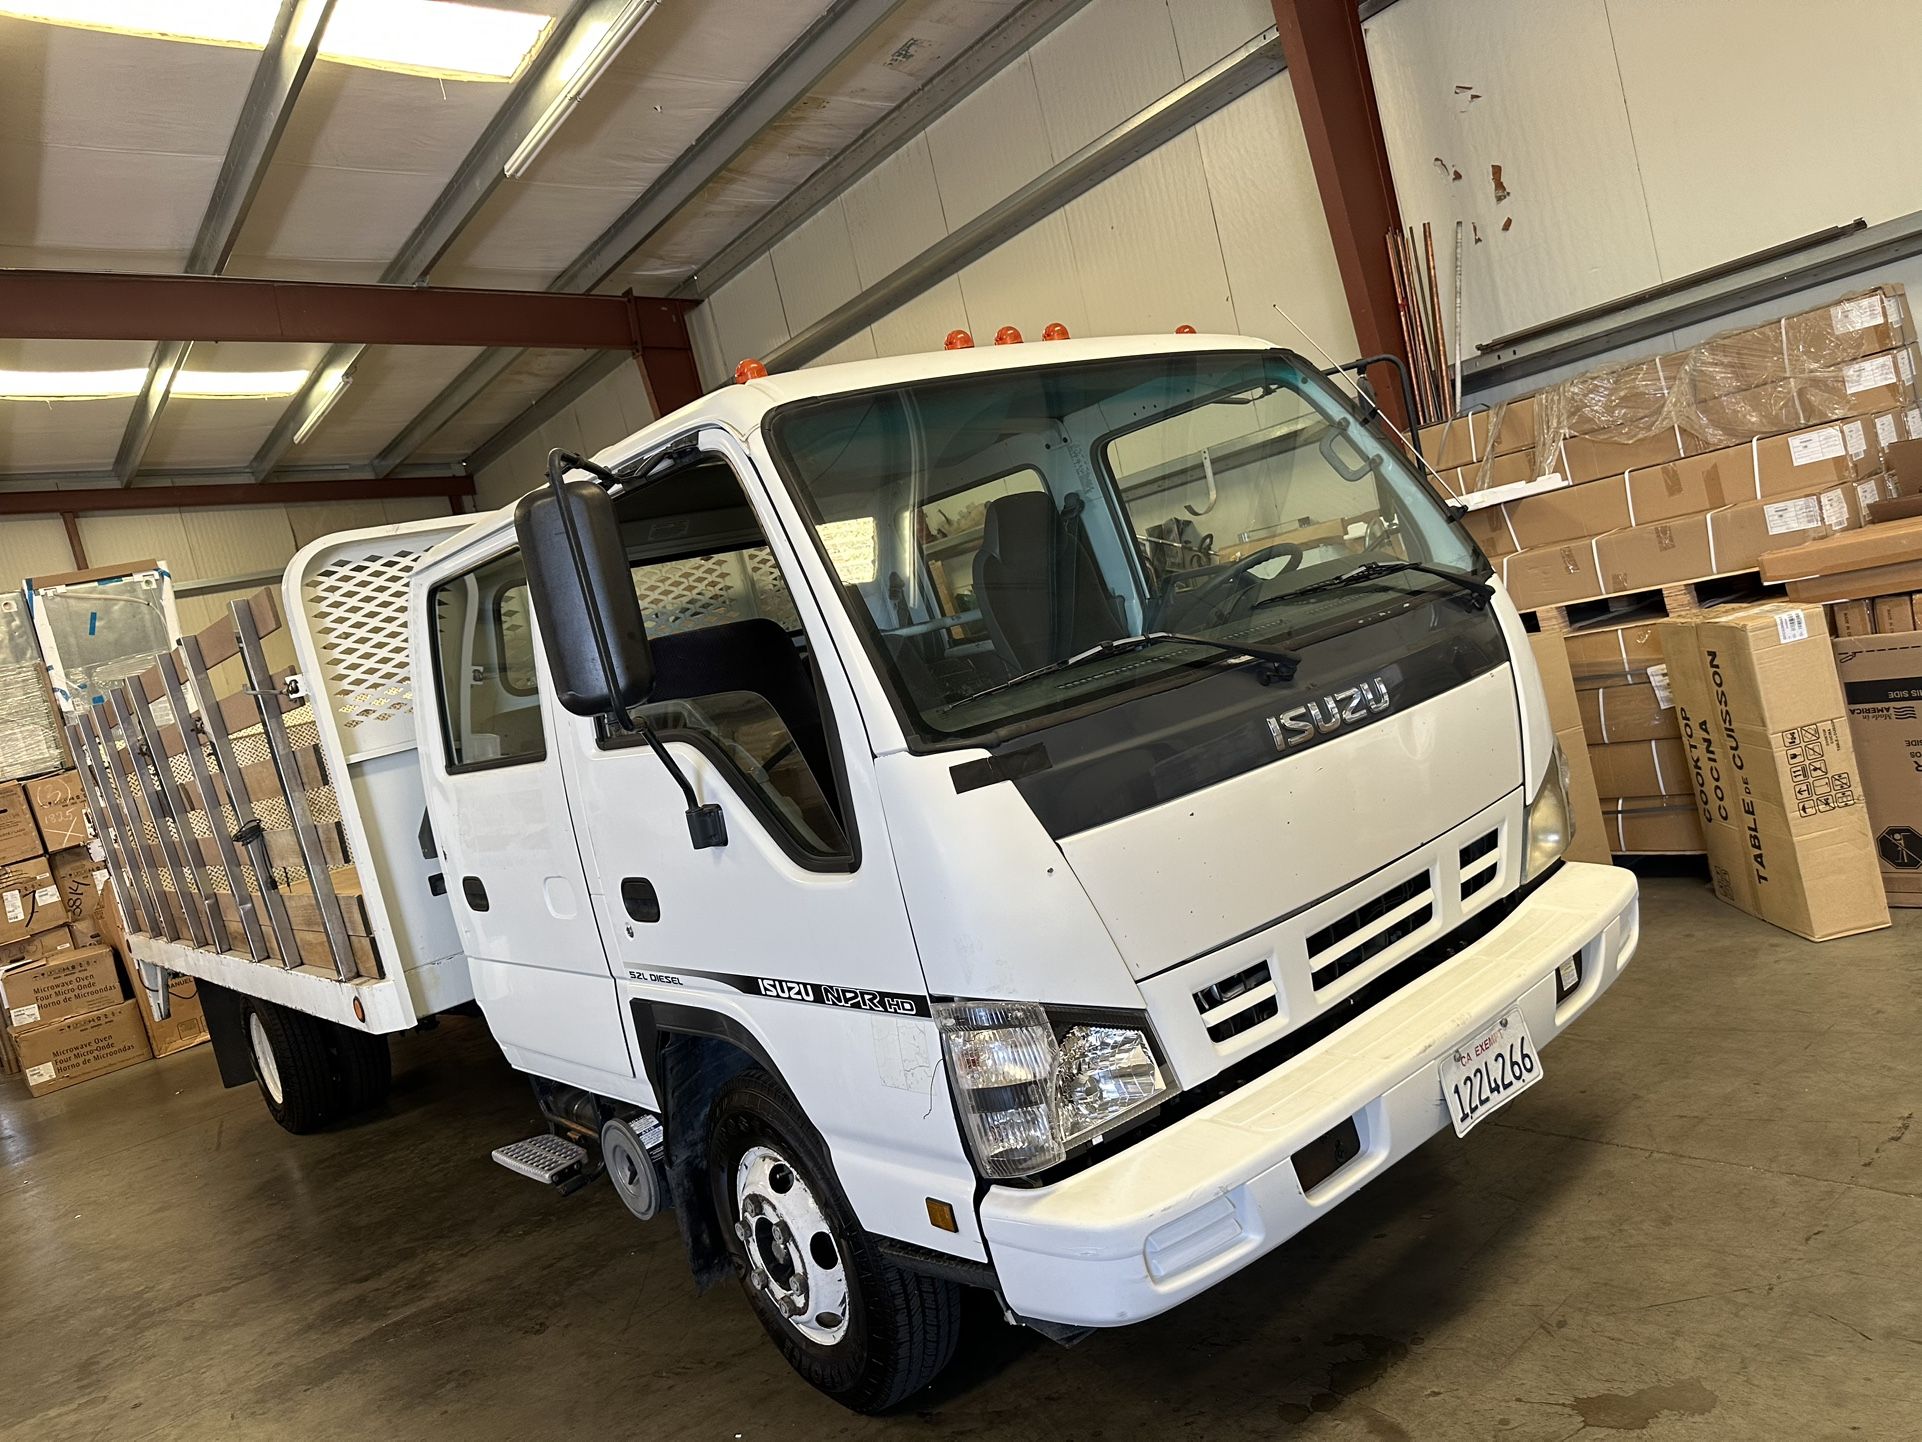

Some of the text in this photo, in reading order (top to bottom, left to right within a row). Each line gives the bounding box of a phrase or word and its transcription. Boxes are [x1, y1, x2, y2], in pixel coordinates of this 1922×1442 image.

[1265, 676, 1391, 752] ISUZU
[1848, 706, 1891, 715] AMERICA
[1680, 706, 1713, 824] COOKTOP
[1699, 718, 1729, 822] COCINA
[1706, 650, 1769, 885] TABLE DE CUISSON
[33, 979, 74, 995] Microwave
[75, 973, 95, 983] Oven
[648, 972, 684, 986] DIESEL
[35, 992, 53, 1003] Four
[37, 999, 61, 1011] Horno
[62, 995, 73, 1004] de
[74, 983, 117, 1001] Microondas
[757, 978, 917, 1015] ISUZU NPR HD
[52, 1034, 113, 1058] Microwave Oven
[54, 1055, 72, 1066] Four
[56, 1062, 81, 1074] Horno
[82, 1057, 92, 1066] de
[93, 1043, 135, 1062] Microondas
[1460, 1028, 1504, 1067] CA EXEMPT
[1453, 1035, 1534, 1123] 1224266
